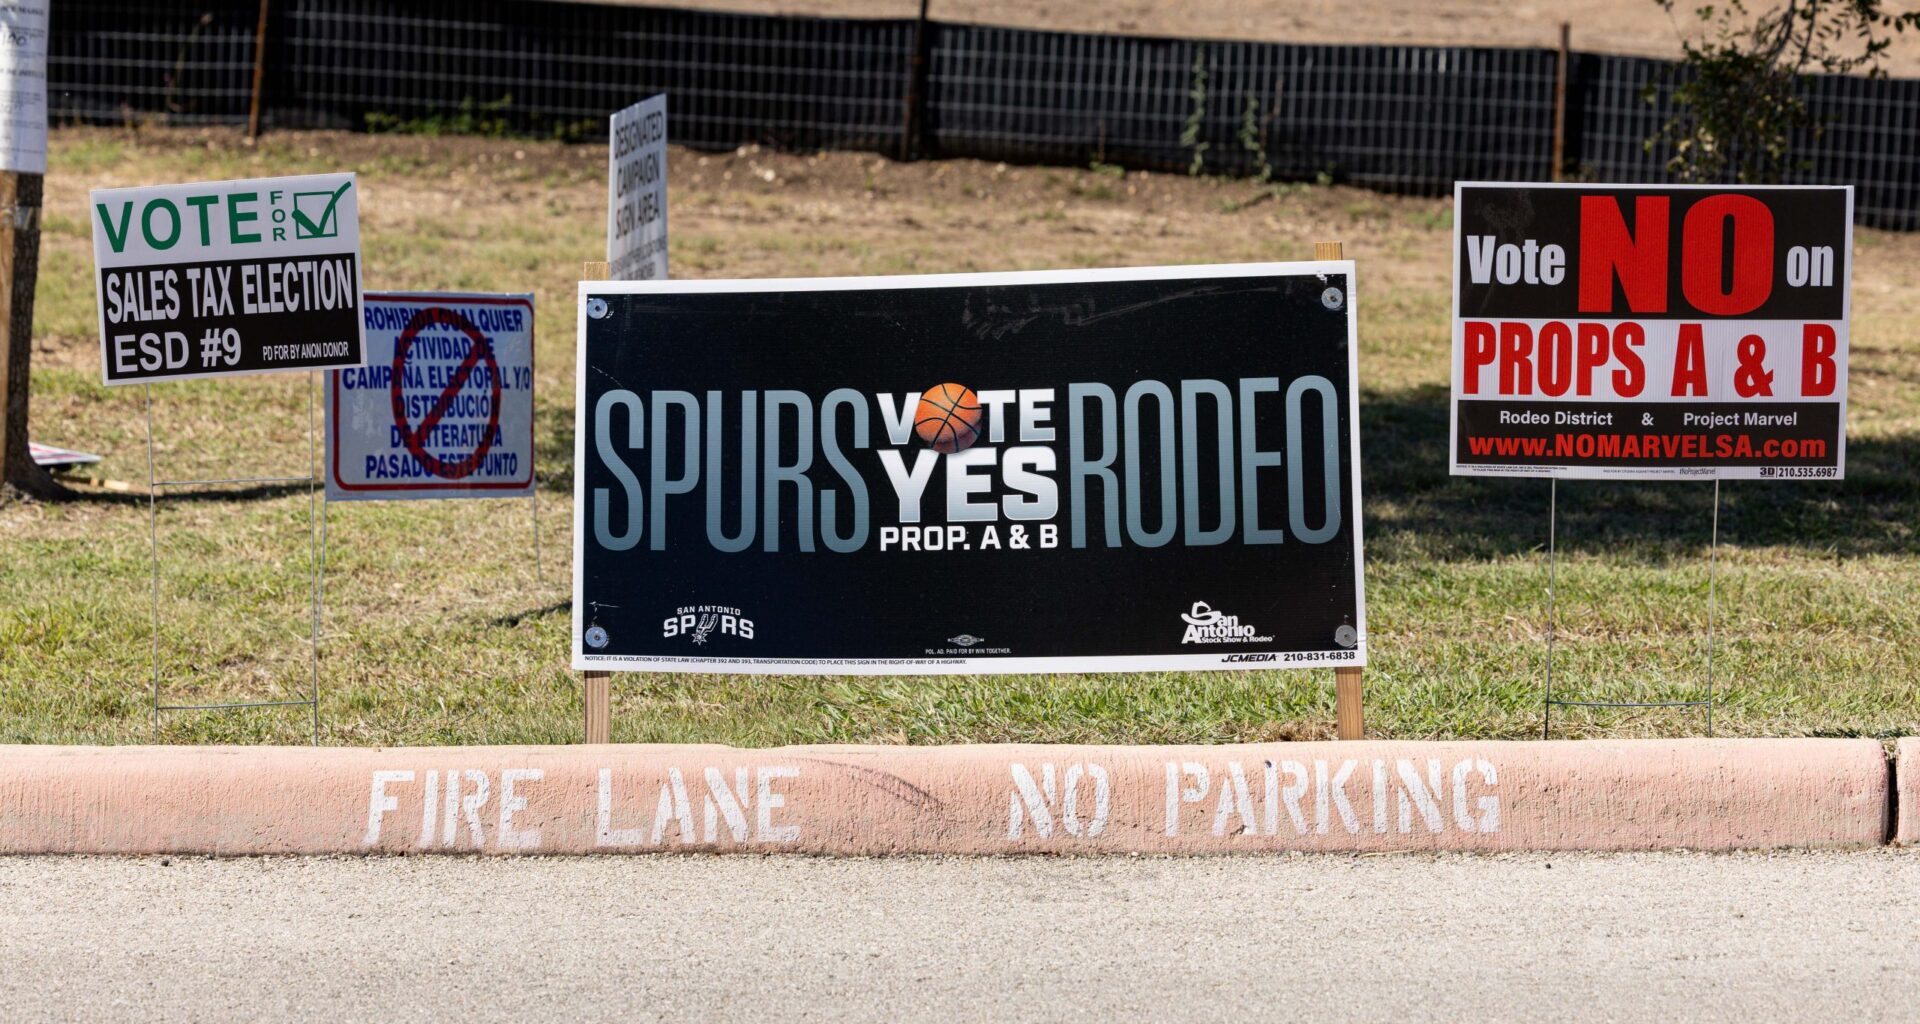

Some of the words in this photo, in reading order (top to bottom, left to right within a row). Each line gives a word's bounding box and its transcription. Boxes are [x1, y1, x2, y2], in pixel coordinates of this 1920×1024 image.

[615, 110, 662, 160] DESIGNATED
[617, 150, 660, 198] CAMPAIGN
[96, 192, 262, 253] VOTE
[270, 190, 287, 242] FOR
[616, 201, 635, 240] SIGN
[636, 190, 660, 228] AREA
[1467, 235, 1566, 286] Vote
[1578, 193, 1775, 316] NO
[1786, 245, 1834, 288] on
[106, 269, 181, 324] SALES
[186, 265, 235, 318] TAX
[241, 258, 353, 315] ELECTION
[364, 306, 437, 331] ROHIBIDA
[438, 308, 523, 333] CUALQUIER
[114, 331, 190, 373] ESD
[200, 327, 242, 368] #9
[262, 345, 273, 361] PD
[274, 344, 289, 360] FOR
[290, 344, 300, 359] BY
[301, 342, 322, 359] ANON
[323, 341, 349, 358] DONOR
[394, 336, 471, 360] ACTIVIDAD
[477, 337, 495, 360] DE
[1463, 320, 1646, 398] PROPS
[1671, 323, 1708, 397] A
[1734, 333, 1774, 398] &
[1801, 323, 1837, 397] B
[342, 361, 424, 390] CAMPAÑA
[428, 365, 510, 389] ELECTORAL
[513, 366, 530, 391] Y/O
[396, 389, 499, 418] DISTRIBUCIÓN
[877, 386, 1056, 447] VOTE
[1500, 410, 1550, 426] Rodeo
[1554, 410, 1613, 426] District
[1641, 412, 1654, 426] &
[1683, 411, 1740, 429] Project
[1744, 411, 1797, 427] Marvel
[417, 424, 503, 448] LITERATURA
[1468, 433, 1826, 459] www.NOMARVELSA.com
[366, 454, 432, 479] PASADO
[477, 452, 517, 476] PUNTO
[594, 387, 870, 553] SPURS
[1068, 375, 1342, 549] RODEO
[1760, 466, 1775, 476] 3D
[1778, 467, 1838, 478] 210.535.6987
[877, 446, 1059, 523] YES
[880, 525, 971, 551] PROP.
[979, 525, 1001, 550] A
[1009, 524, 1031, 550] &
[1040, 523, 1059, 549] B
[676, 606, 696, 616] SAN
[698, 605, 741, 616] ANTONIO
[1181, 624, 1256, 644] Antonio
[1221, 653, 1277, 663] JCMEDIA
[1283, 651, 1356, 662] 210-831-6838
[362, 767, 544, 850] FIRE
[596, 766, 802, 848] LANE
[1007, 761, 1110, 841] NO
[1165, 758, 1500, 838] PARKING
